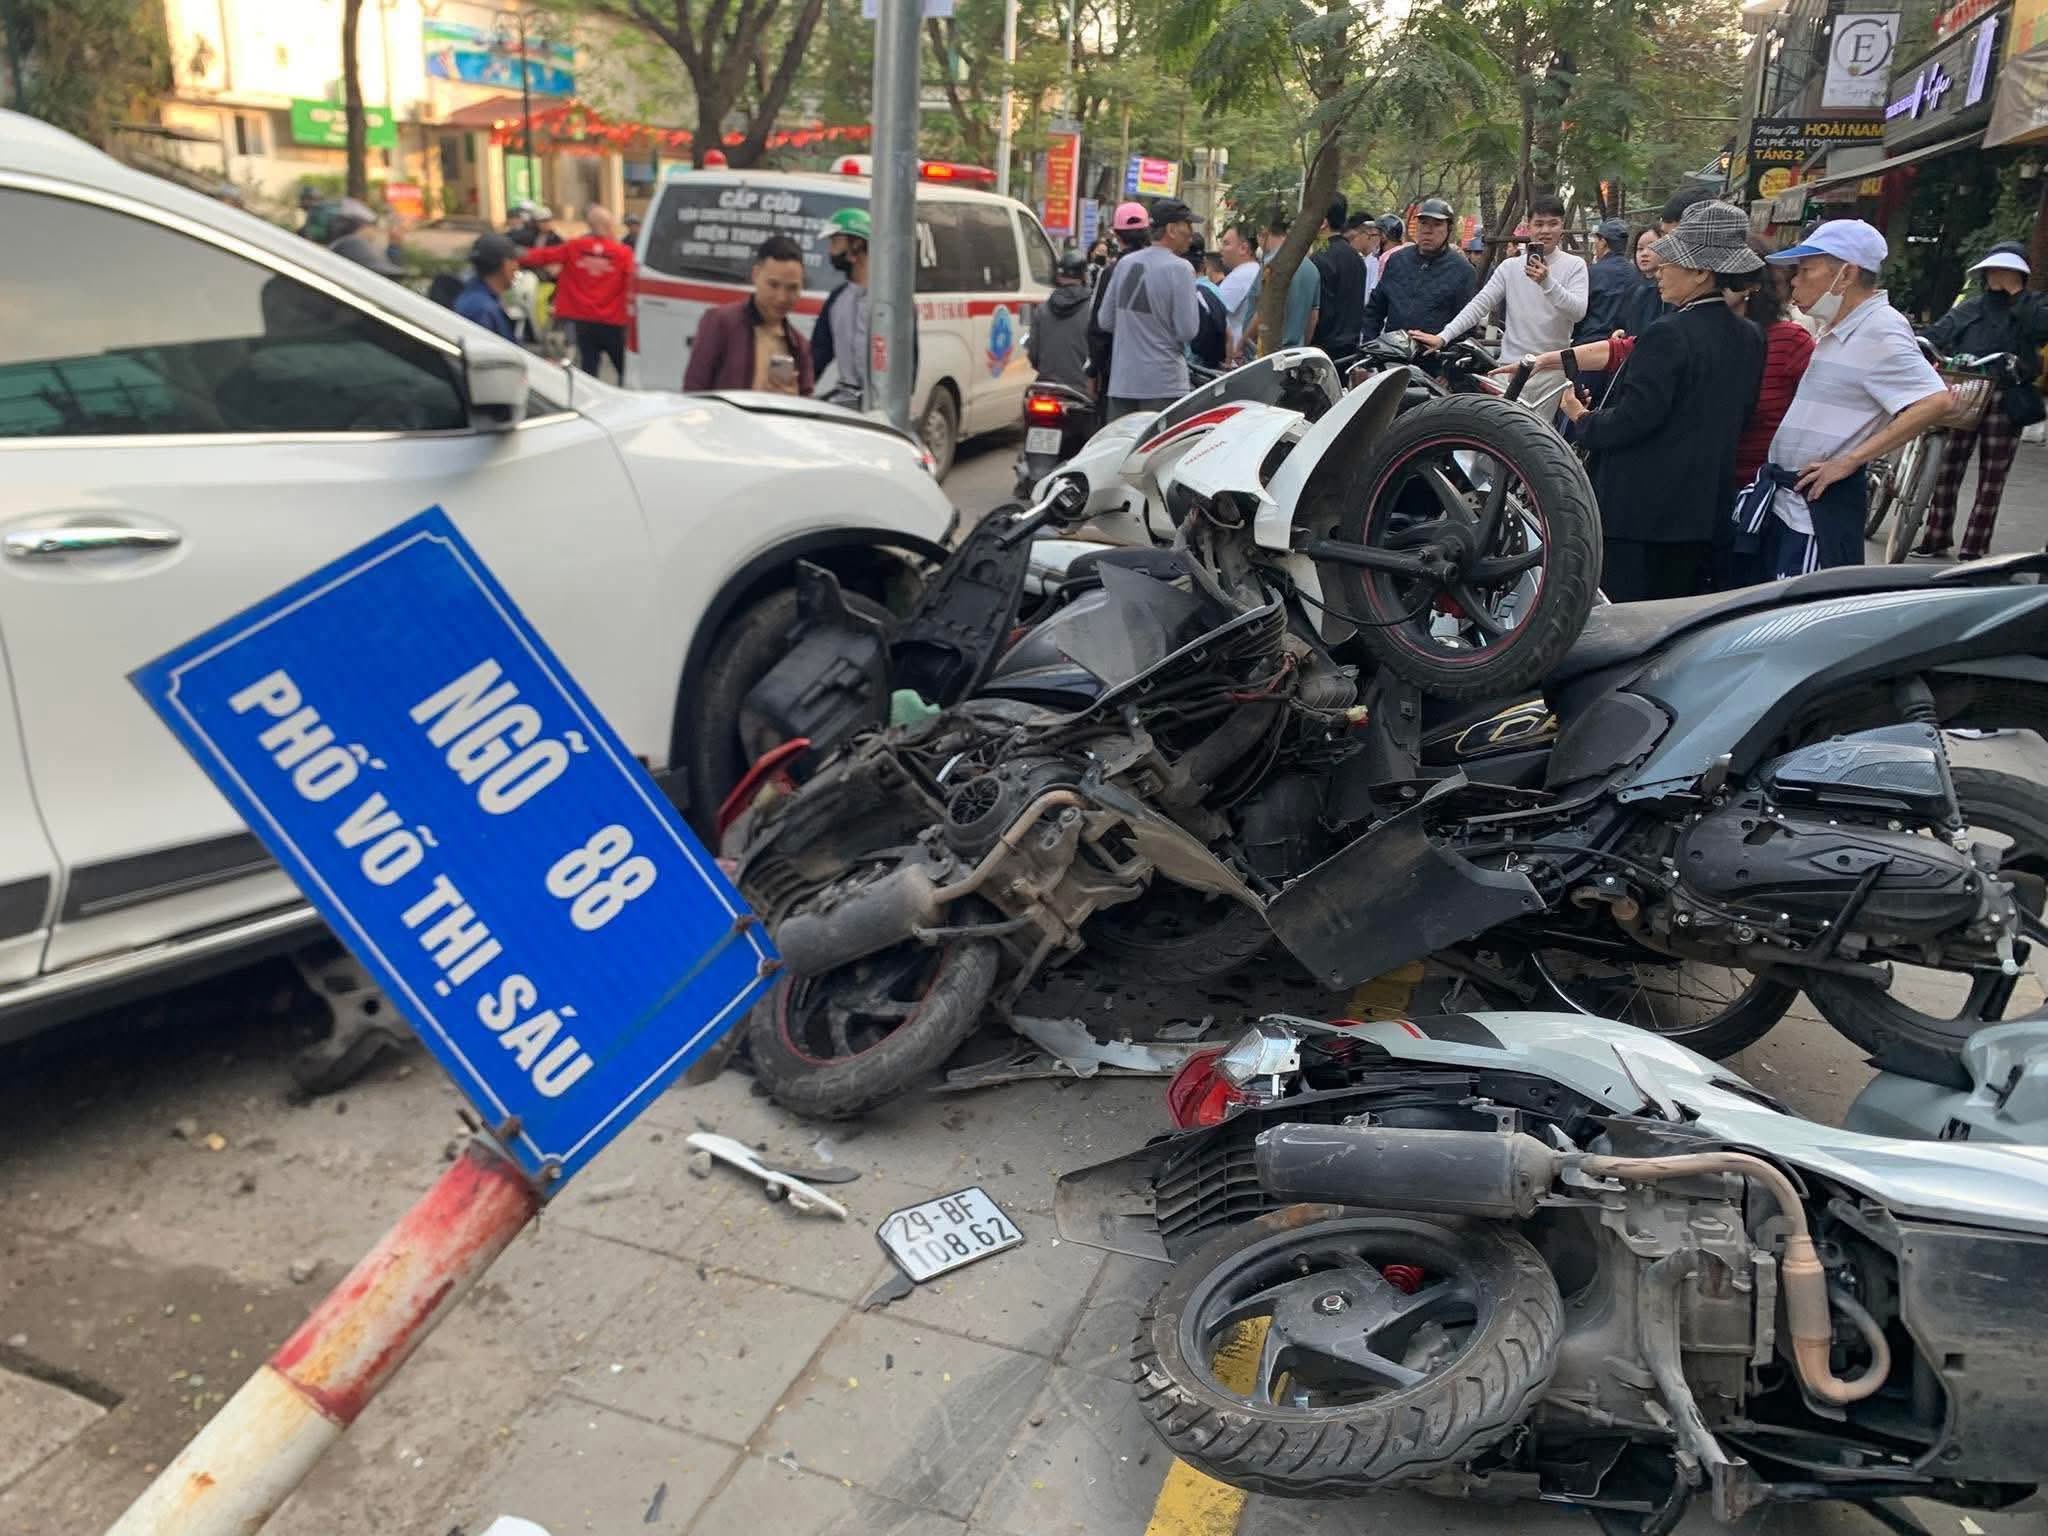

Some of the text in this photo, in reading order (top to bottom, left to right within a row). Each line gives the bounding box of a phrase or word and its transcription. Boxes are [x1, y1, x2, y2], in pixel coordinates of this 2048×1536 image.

[1850, 34, 1876, 63] E
[1794, 150, 1805, 160] 2
[409, 658, 657, 931] NGÕ 88
[229, 668, 595, 1098] PHỐ VÕ THỊ SÁU
[883, 1194, 975, 1242] 29-BF
[909, 1217, 1016, 1270] 108.62
